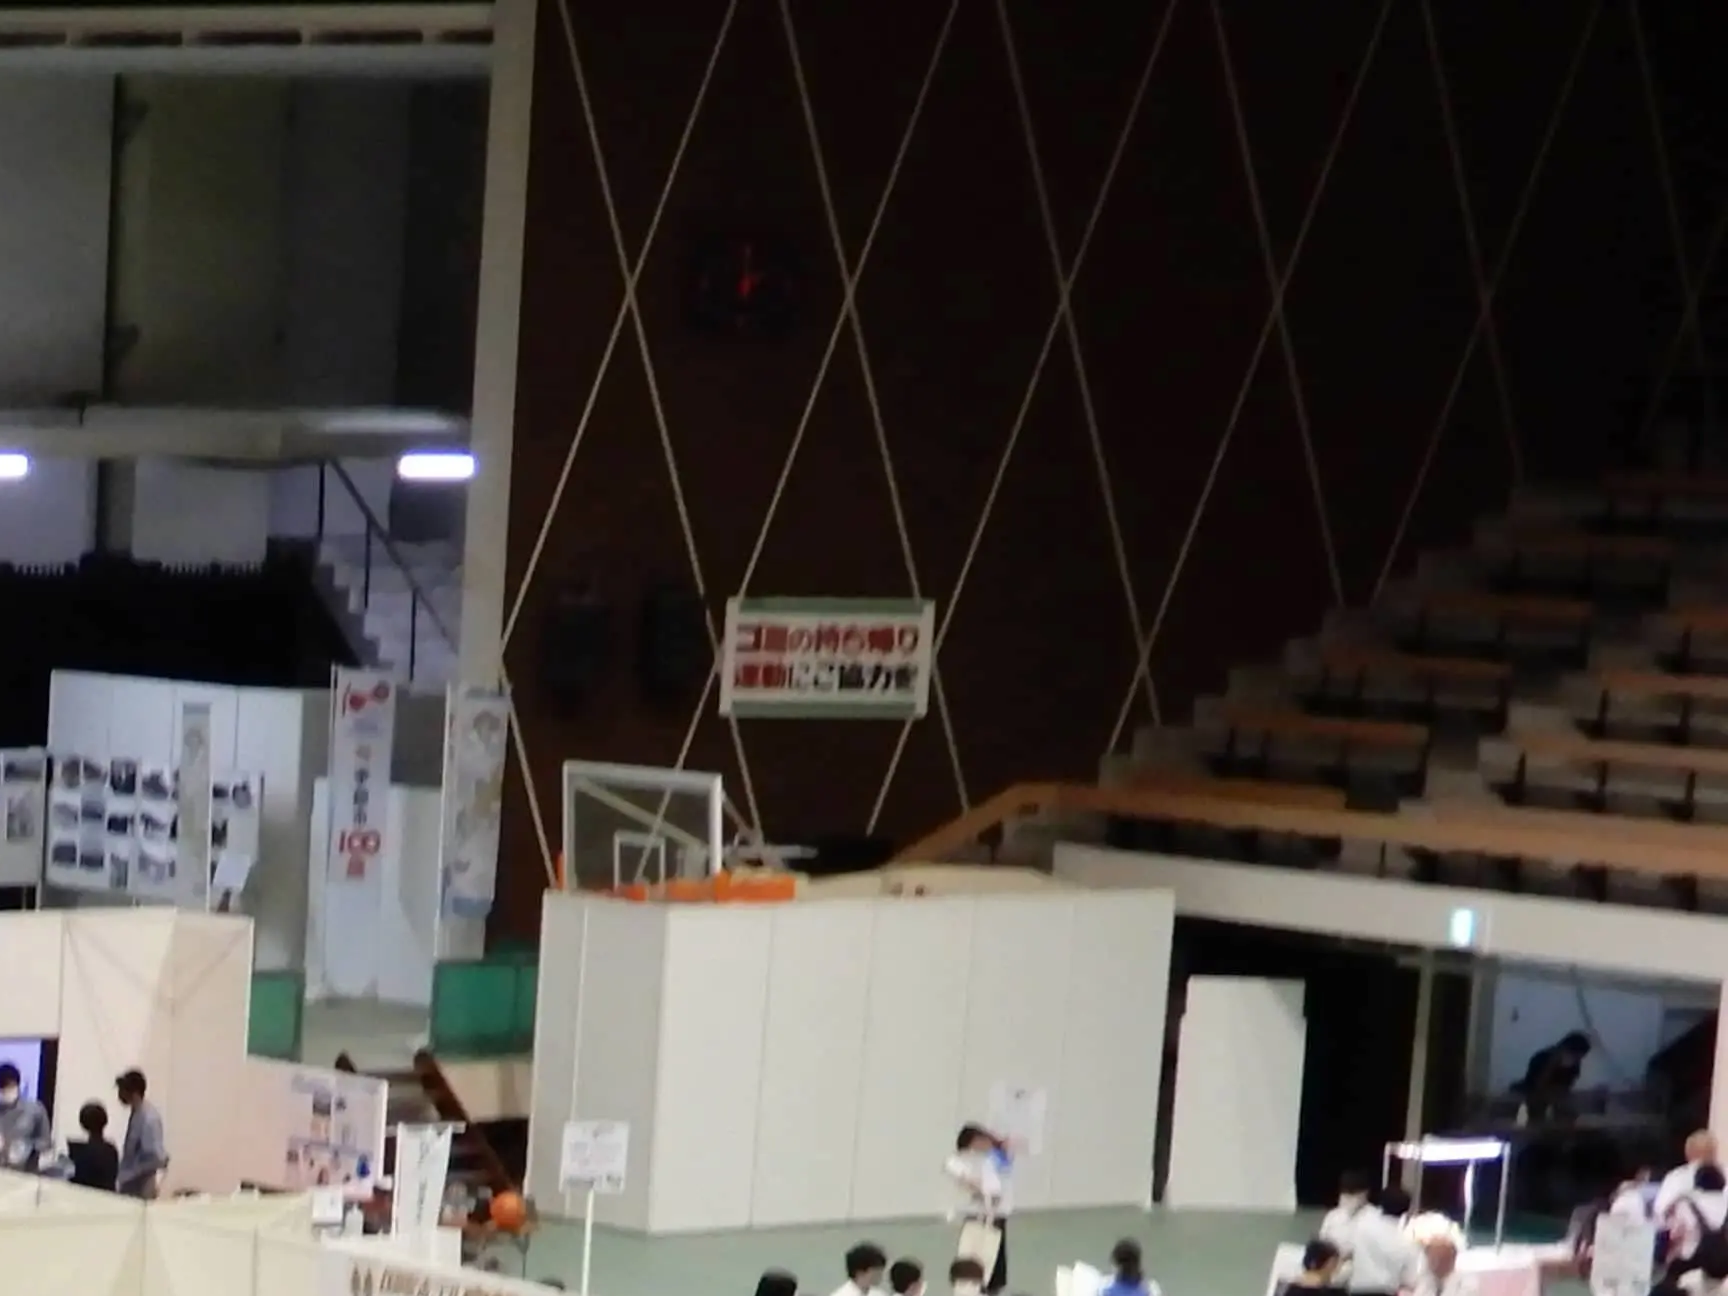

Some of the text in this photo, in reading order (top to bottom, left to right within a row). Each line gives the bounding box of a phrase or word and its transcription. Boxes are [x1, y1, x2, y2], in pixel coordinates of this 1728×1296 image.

[735, 623, 920, 655] ゴミの持ち帰り
